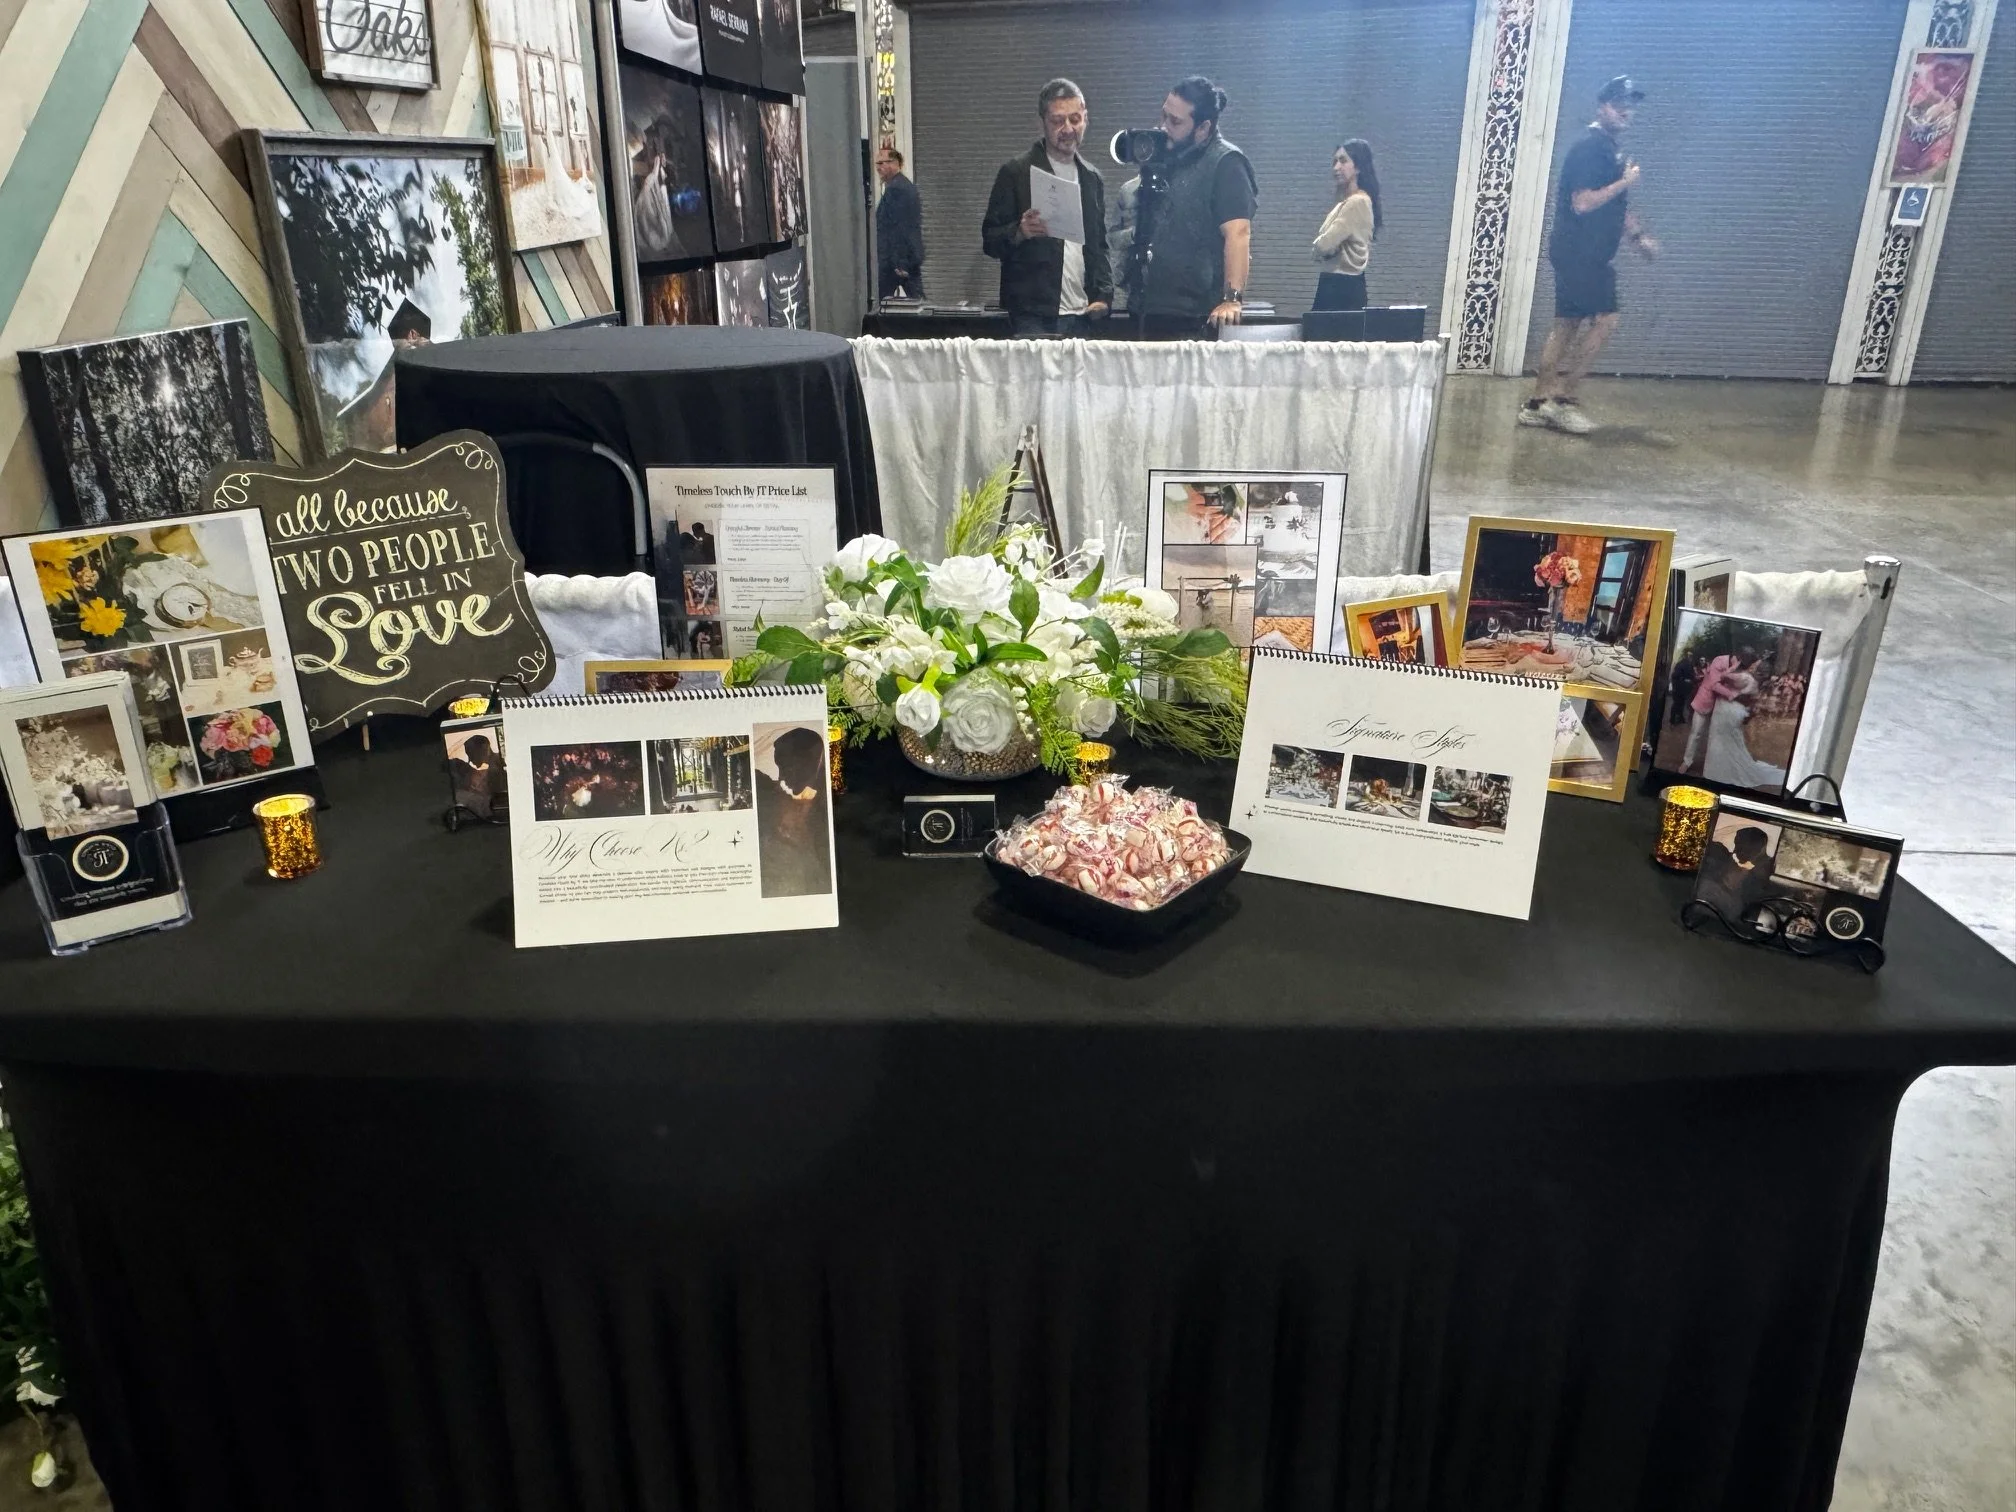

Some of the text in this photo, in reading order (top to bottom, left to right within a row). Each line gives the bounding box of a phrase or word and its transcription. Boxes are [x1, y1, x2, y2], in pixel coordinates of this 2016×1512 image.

[326, 0, 428, 56] Oaks
[276, 488, 458, 538] all because
[674, 485, 713, 496] Timeless
[714, 485, 741, 496] Touch
[743, 486, 754, 498] By
[768, 485, 789, 496] Price
[792, 485, 808, 496] List
[273, 522, 496, 595] TWO PEOPLE
[373, 568, 473, 604] FELL IN
[294, 591, 515, 685] Love
[1326, 714, 1477, 759] Signature Styles
[520, 825, 584, 875] Why
[589, 829, 643, 870] Choose
